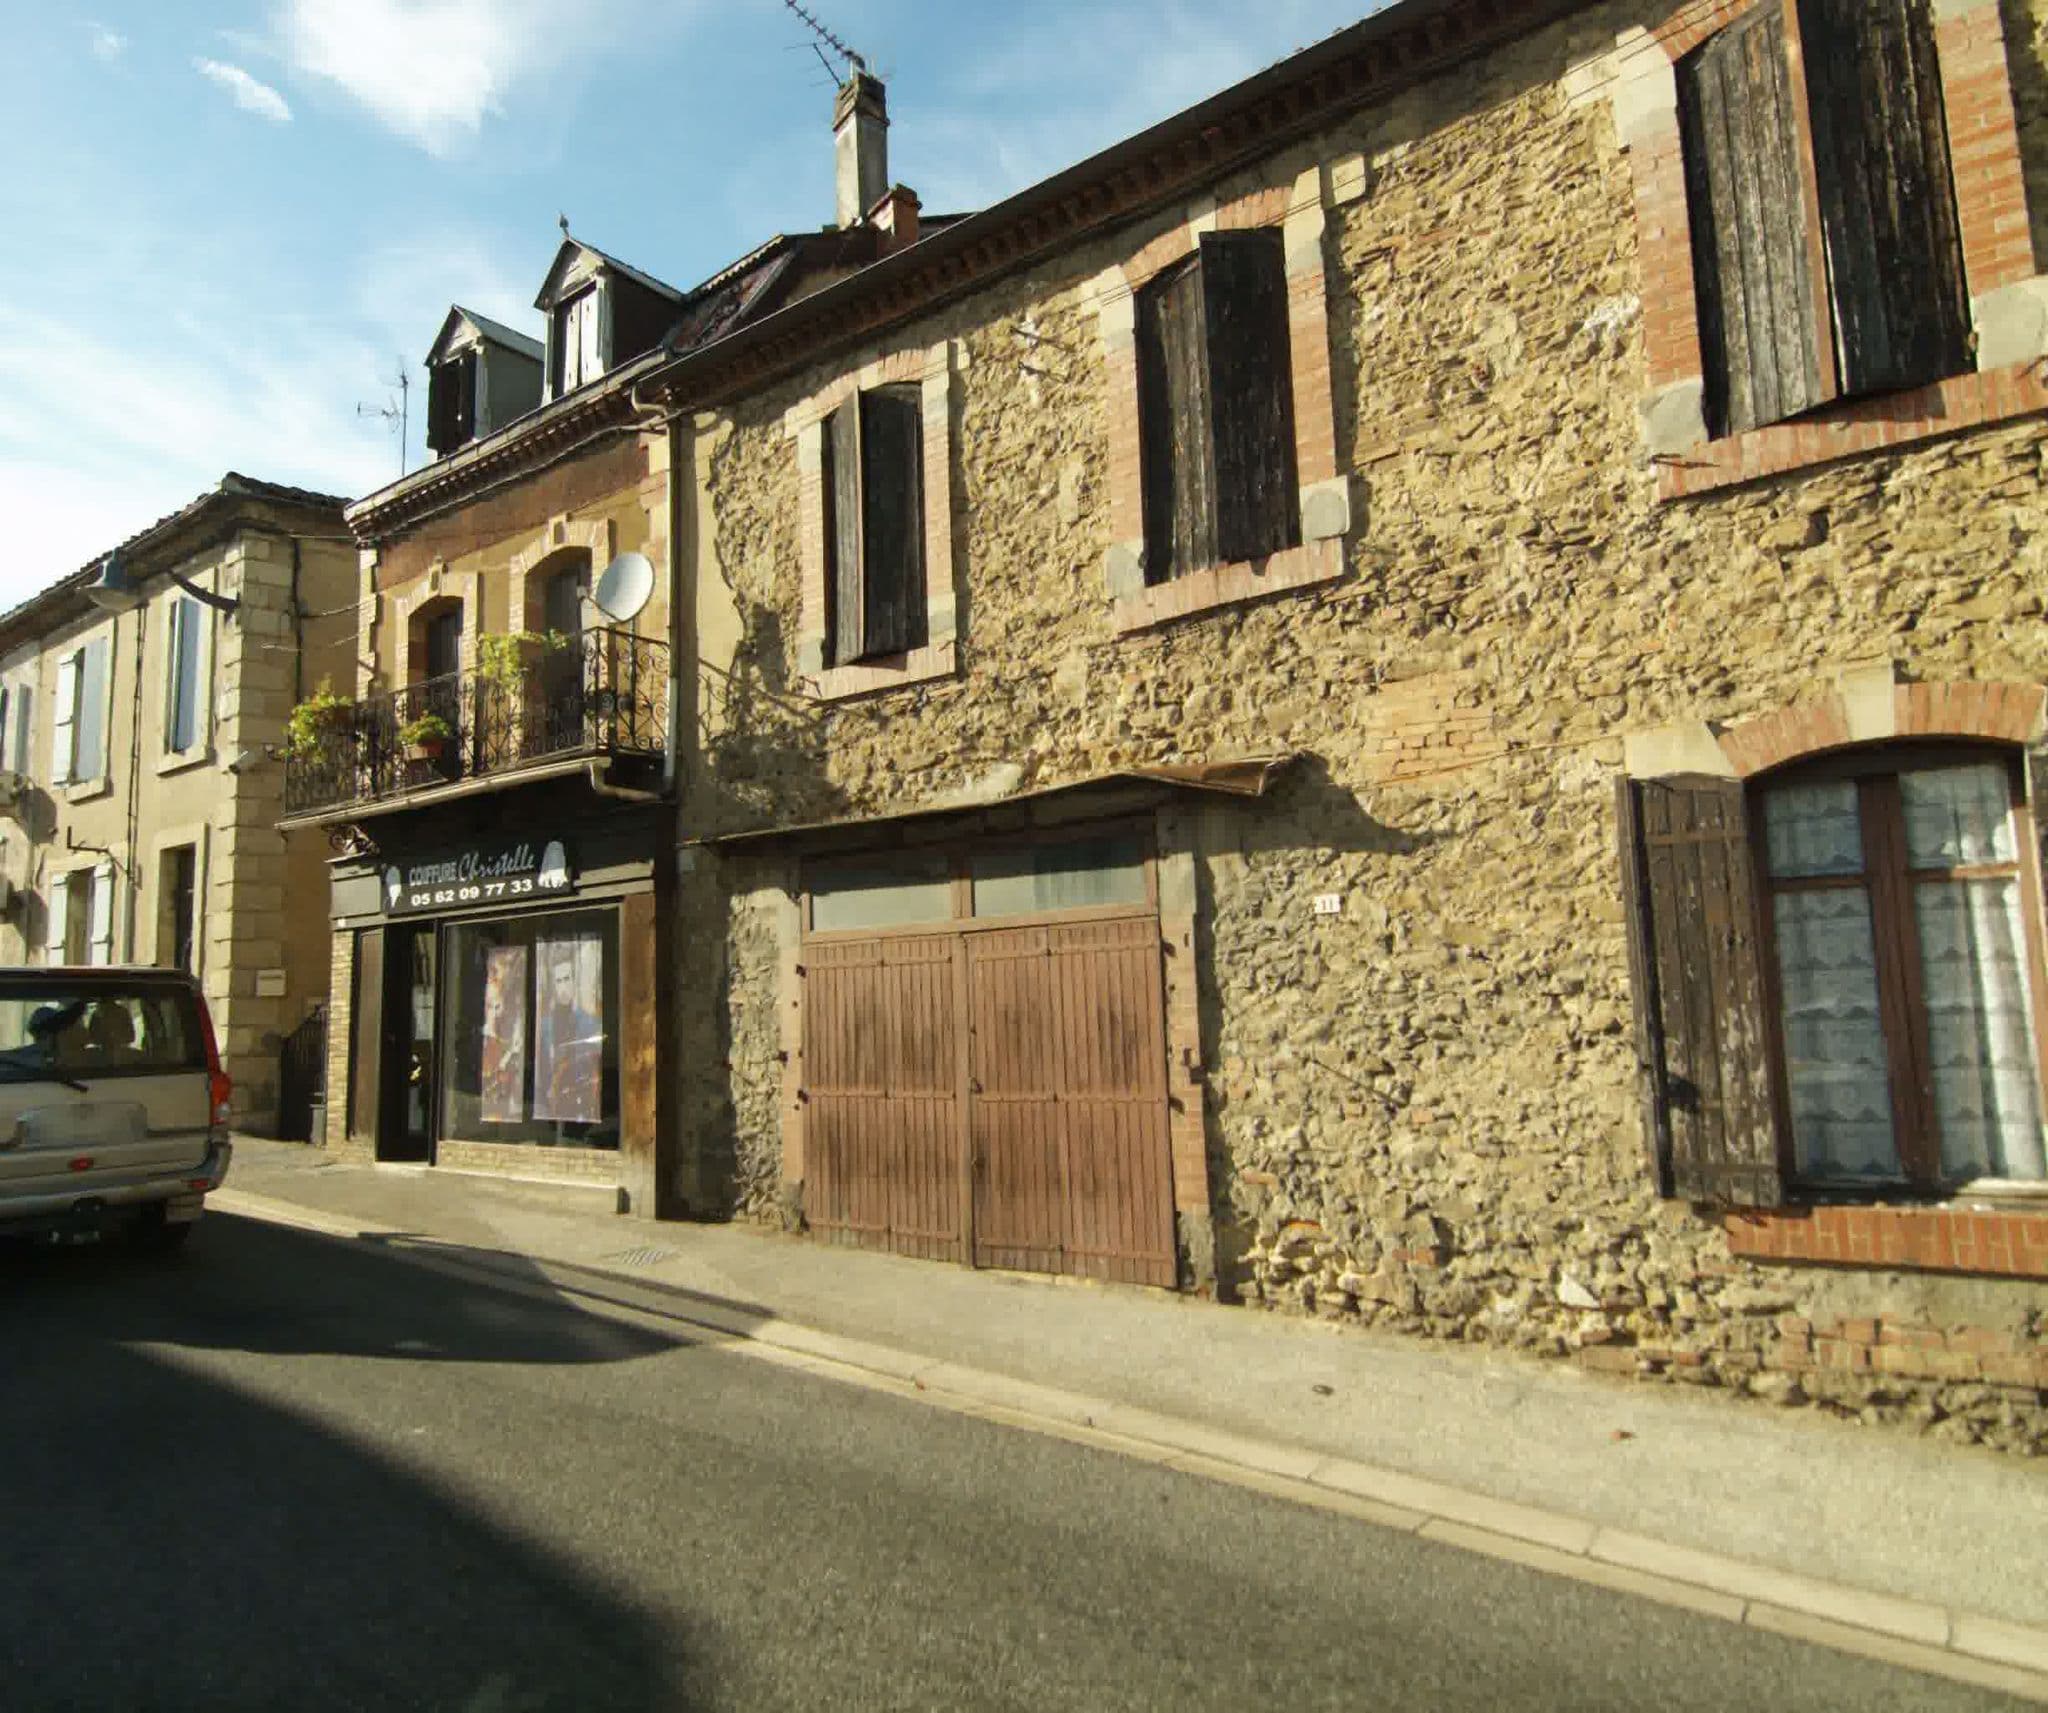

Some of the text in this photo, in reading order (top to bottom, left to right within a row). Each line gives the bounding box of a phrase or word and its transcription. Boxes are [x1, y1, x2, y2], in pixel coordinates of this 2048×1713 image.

[409, 843, 535, 887] COIFFURE Christelle
[411, 879, 533, 907] 05 62 09 77 33
[1320, 898, 1334, 911] 11
